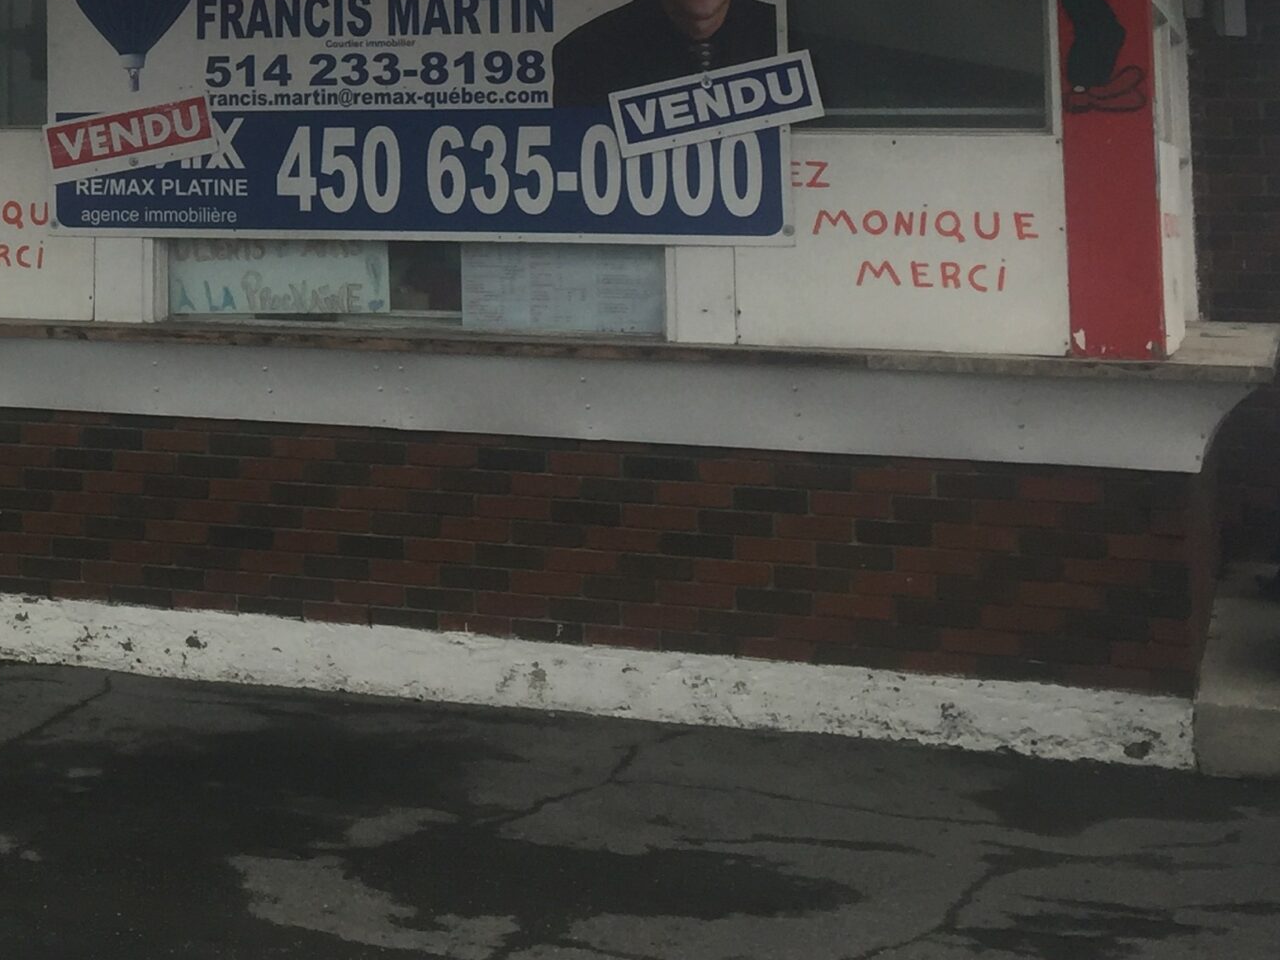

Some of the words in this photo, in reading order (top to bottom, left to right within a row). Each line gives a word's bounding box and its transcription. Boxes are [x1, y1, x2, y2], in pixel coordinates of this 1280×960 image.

[324, 39, 364, 49] Courtier
[365, 37, 417, 48] immobilier
[205, 53, 292, 88] 514
[308, 49, 547, 87] 233-8198
[206, 86, 550, 109] rancis.martin@remax-québec.com
[624, 66, 805, 136] VENDU
[55, 104, 202, 161] VENDU
[276, 124, 402, 214] 450
[426, 123, 763, 218] 635-0000
[790, 160, 830, 188] EZ
[75, 177, 155, 196] RE/MAX
[161, 178, 248, 197] PLATINE
[80, 208, 140, 225] agence
[144, 206, 238, 224] immobilière
